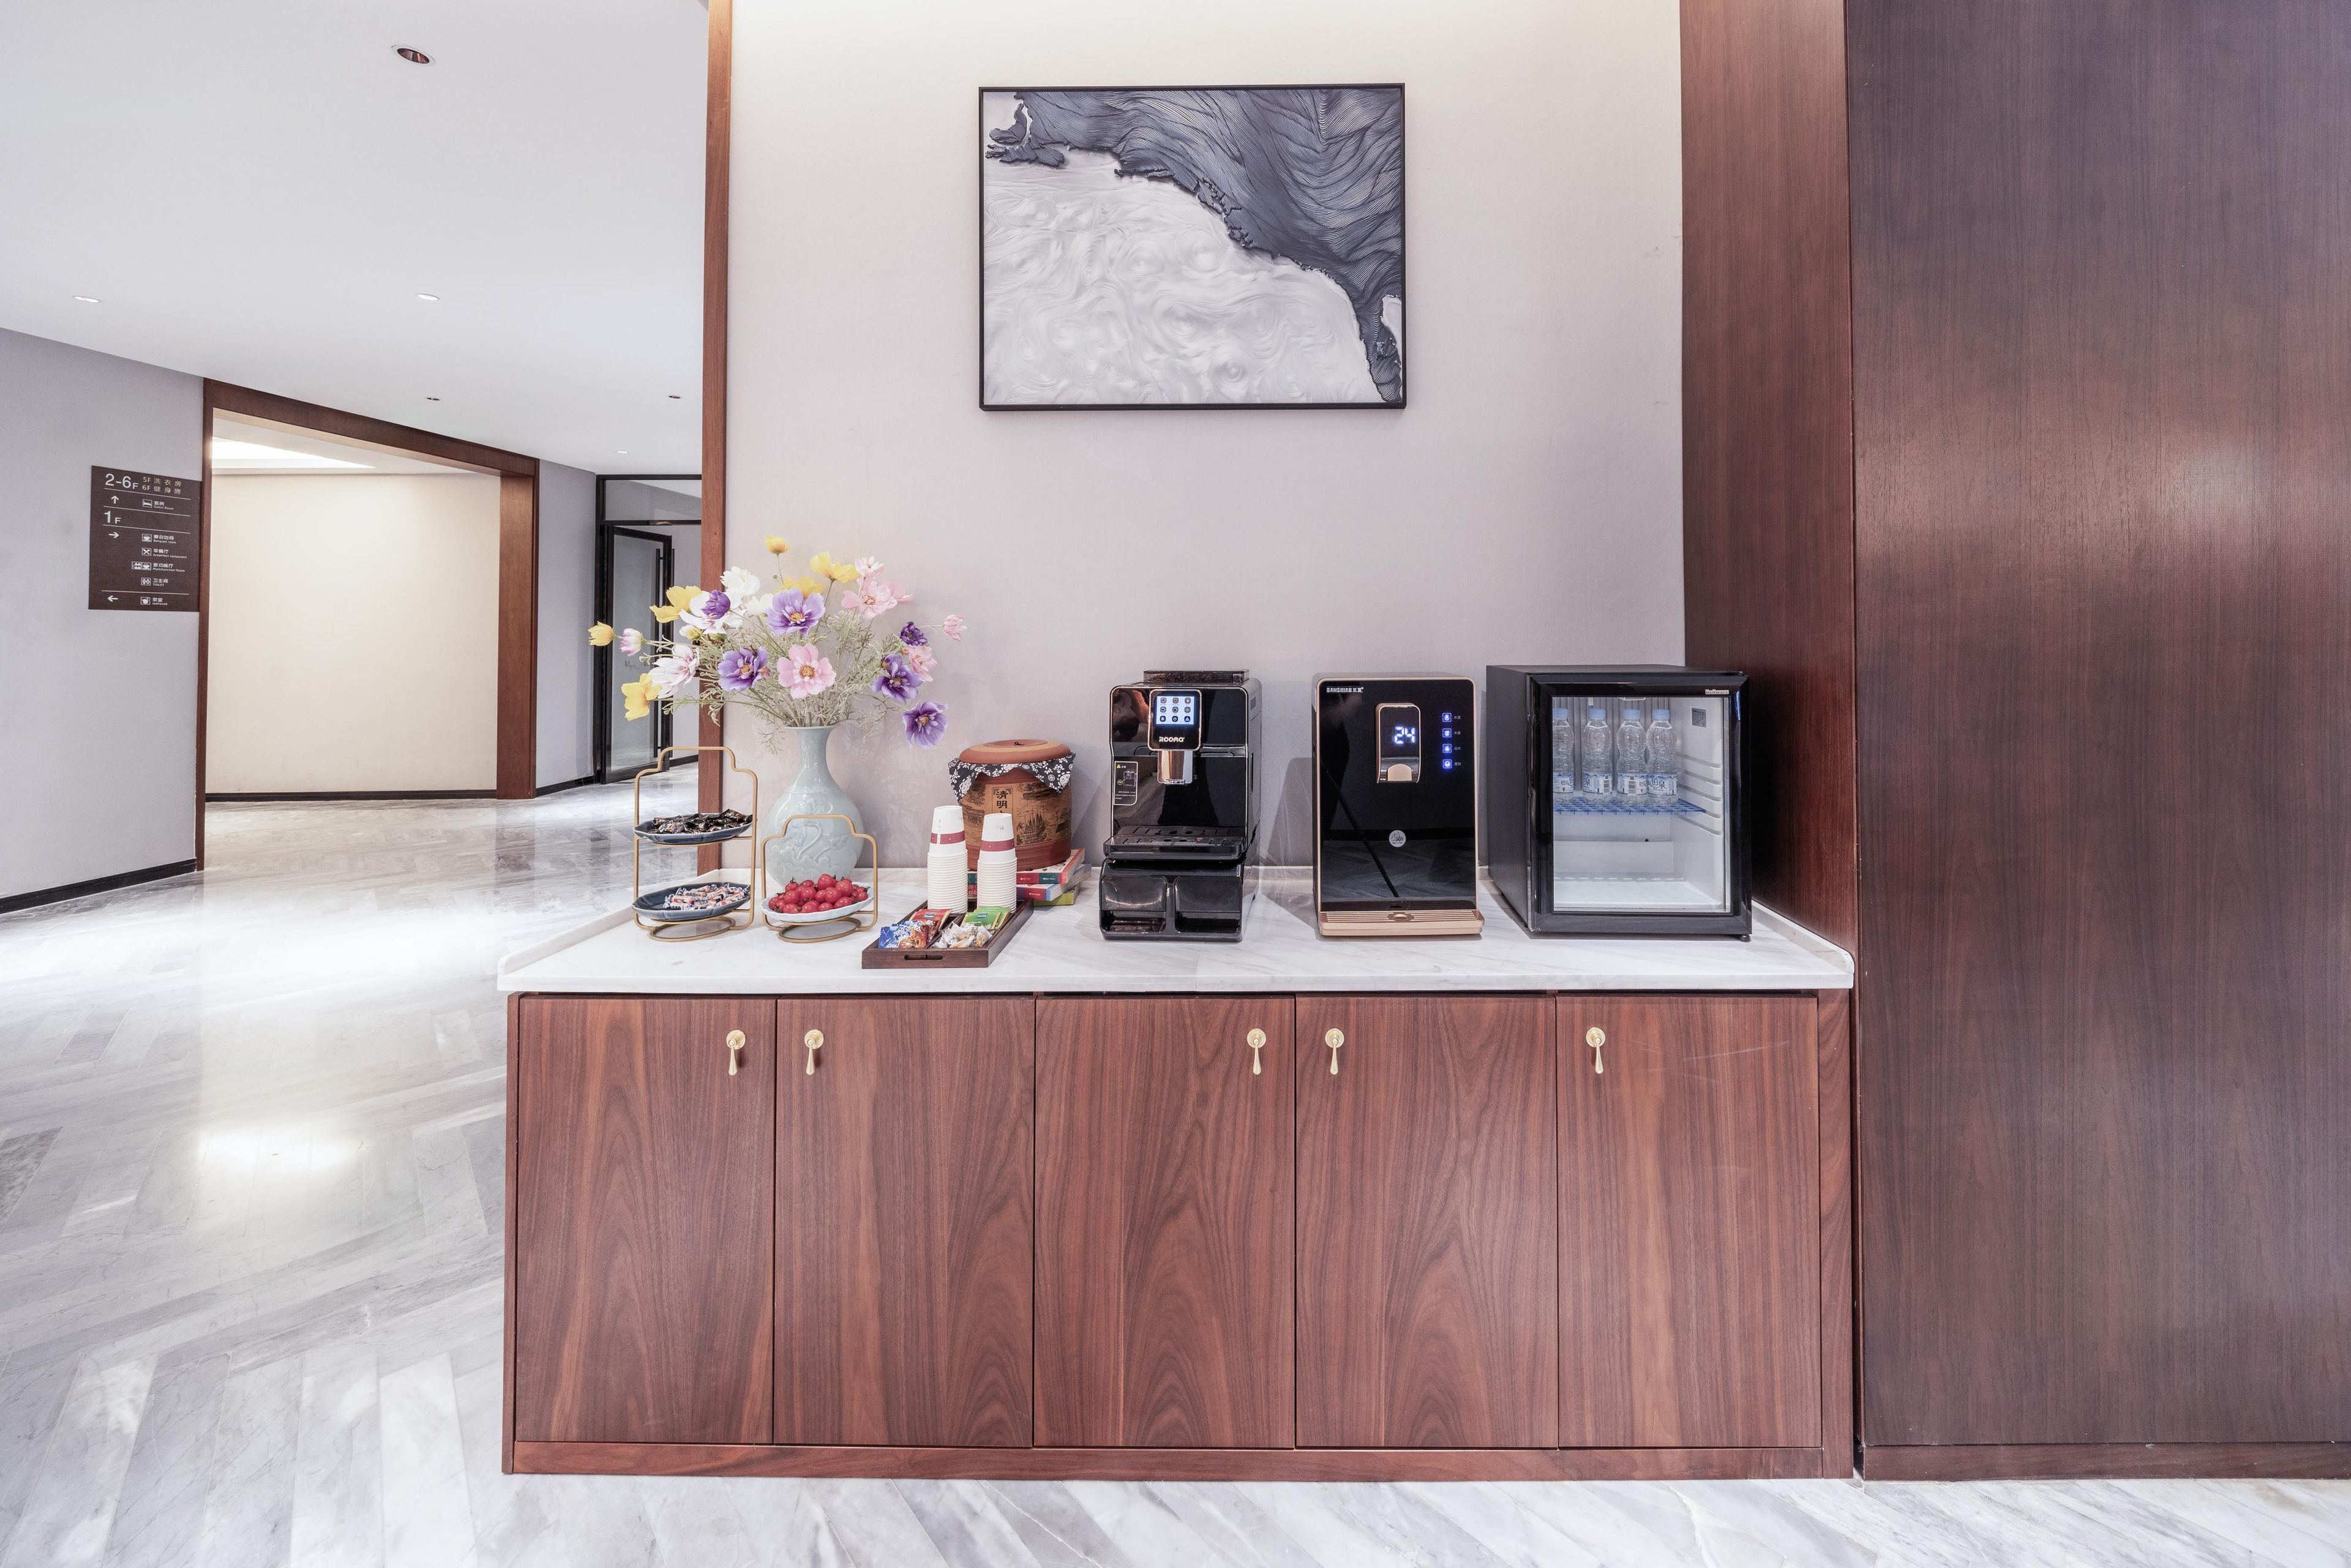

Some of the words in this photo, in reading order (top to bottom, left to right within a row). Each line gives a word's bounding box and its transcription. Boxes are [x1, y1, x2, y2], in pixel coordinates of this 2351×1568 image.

[105, 473, 139, 489] 2-6F
[154, 478, 181, 487] 洗衣房
[154, 486, 181, 495] 健身房
[1394, 727, 1415, 745] 24
